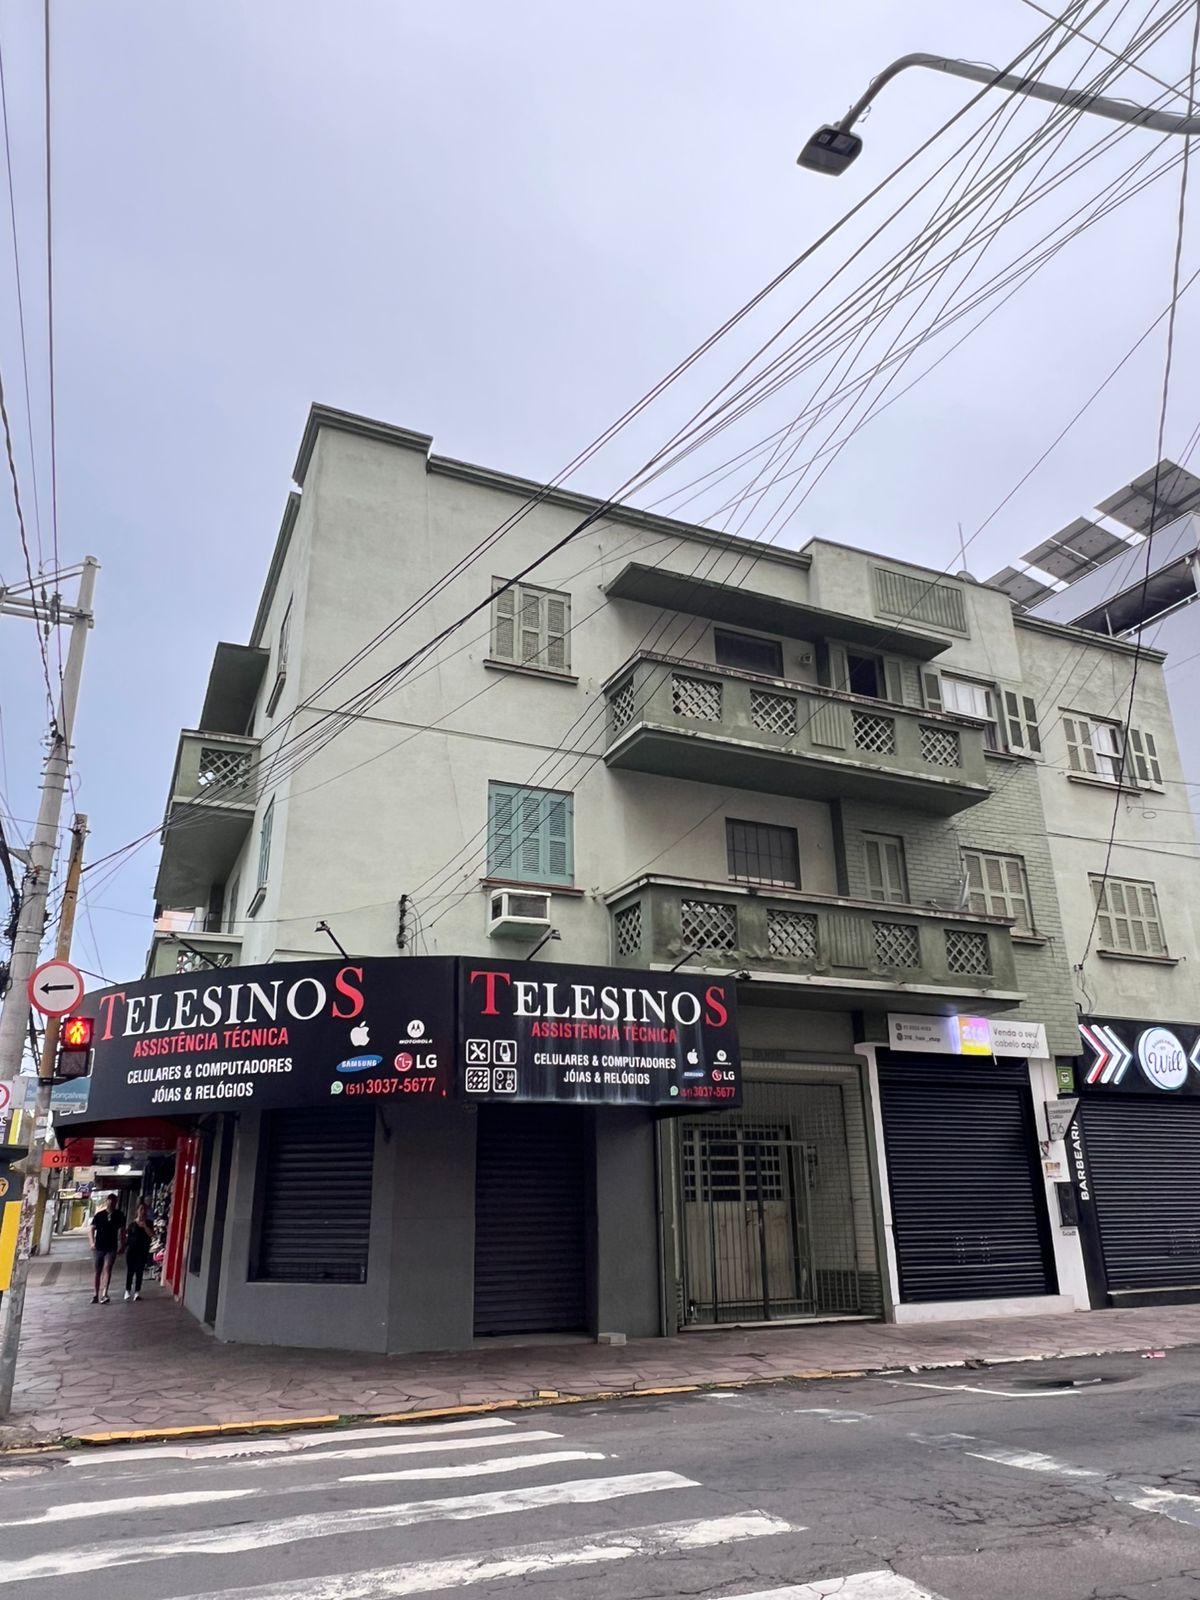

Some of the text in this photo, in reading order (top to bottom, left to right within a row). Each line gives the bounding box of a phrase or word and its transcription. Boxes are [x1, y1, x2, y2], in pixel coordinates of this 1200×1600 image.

[99, 966, 365, 1041] TELESINOS
[470, 971, 728, 1028] TELESINOS
[532, 1020, 677, 1043] ASSISTÊNCIA TÉCNICA
[993, 1028, 1017, 1038] Venda
[133, 1026, 289, 1057] ASSISTÊNCIA TÉCNICA
[994, 1038, 1019, 1048] cabelo
[341, 1058, 377, 1068] SAMSUNG
[416, 1054, 438, 1069] LG
[534, 1053, 677, 1070] CELULARES & COMPUTADORES
[1148, 1050, 1183, 1074] Will
[127, 1057, 293, 1084] CELULARES & COMPUTADORES
[563, 1068, 650, 1085] JÓIAS & RELÓGIOS
[723, 1071, 735, 1080] LG
[151, 1080, 254, 1104] JÓIAS & RELÓGIOS
[346, 1077, 437, 1095] (51) 3037-5677
[693, 1085, 736, 1097] 3037-5677
